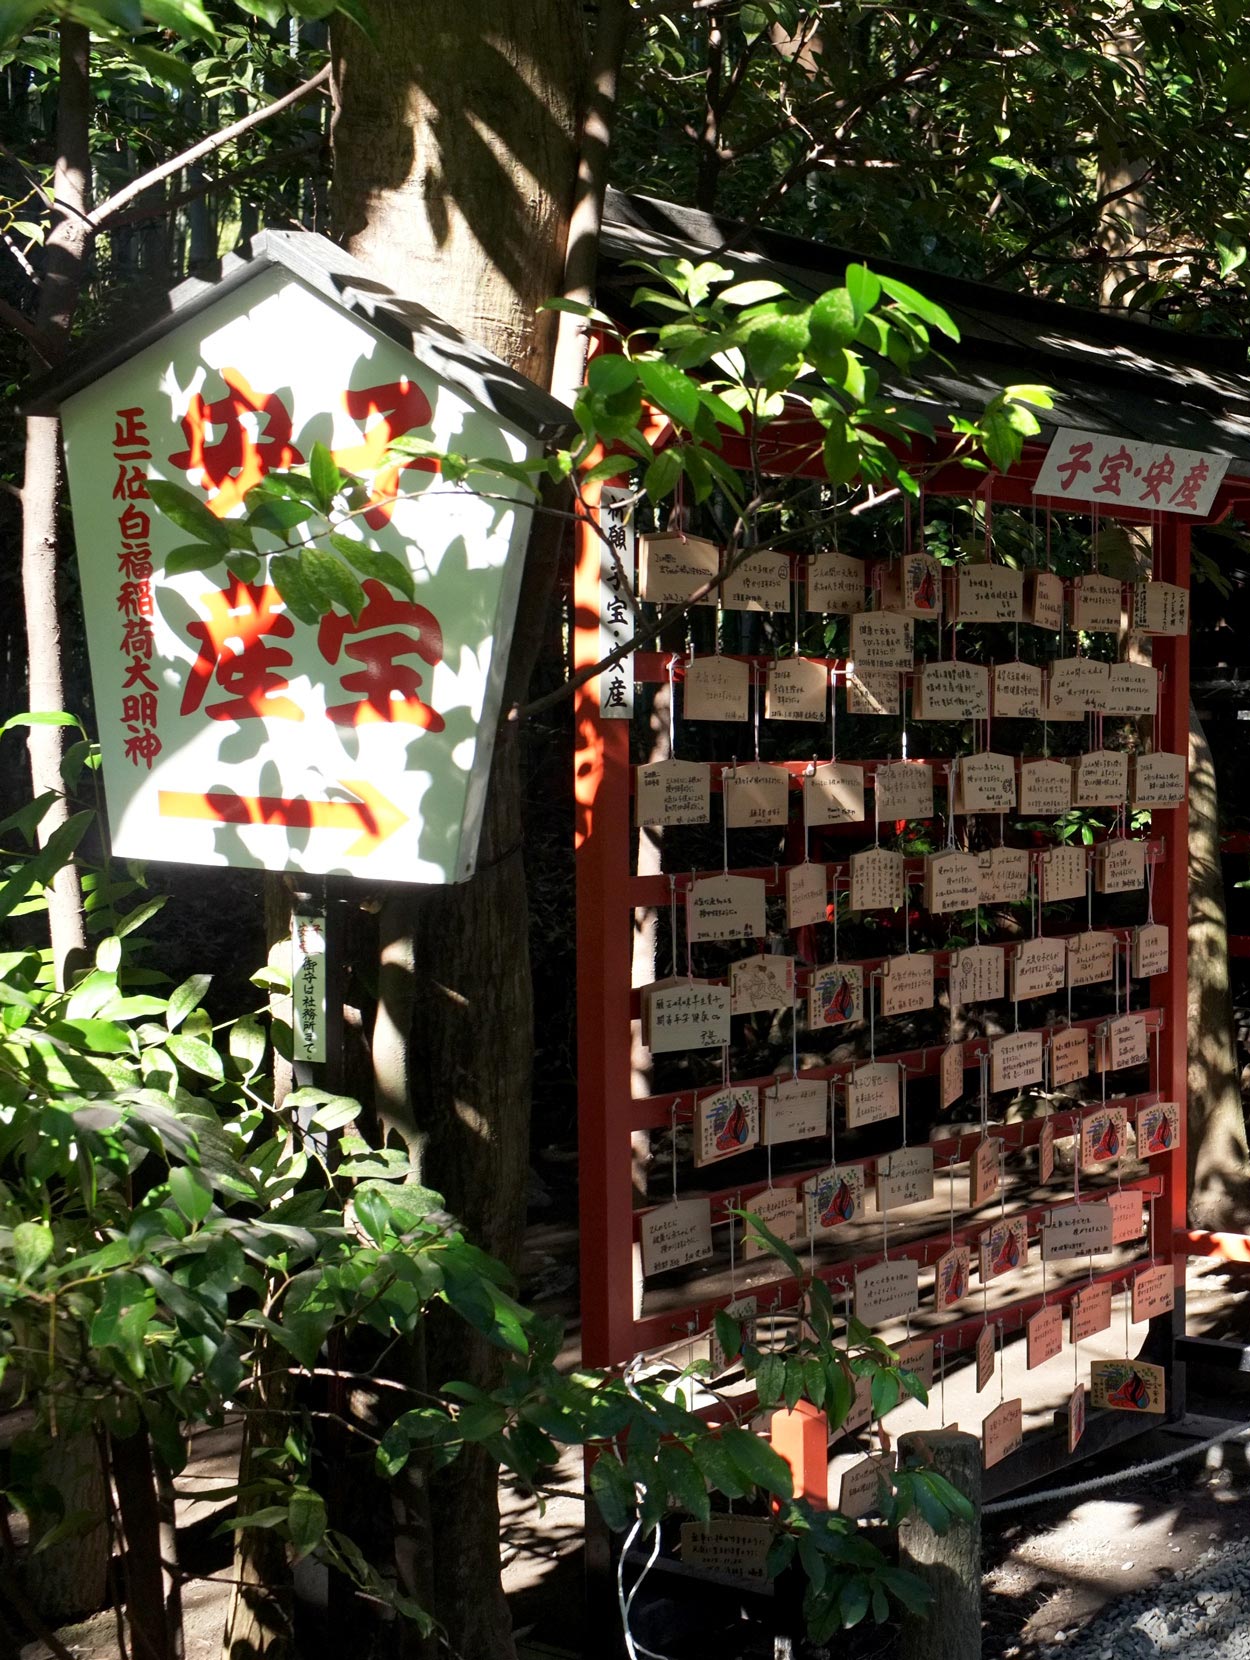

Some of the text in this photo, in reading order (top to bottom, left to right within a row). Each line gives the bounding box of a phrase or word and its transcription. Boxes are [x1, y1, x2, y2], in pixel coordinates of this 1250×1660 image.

[1057, 442, 1209, 510] 子宝・安産
[111, 407, 163, 769] 正一位白福稲荷大明神
